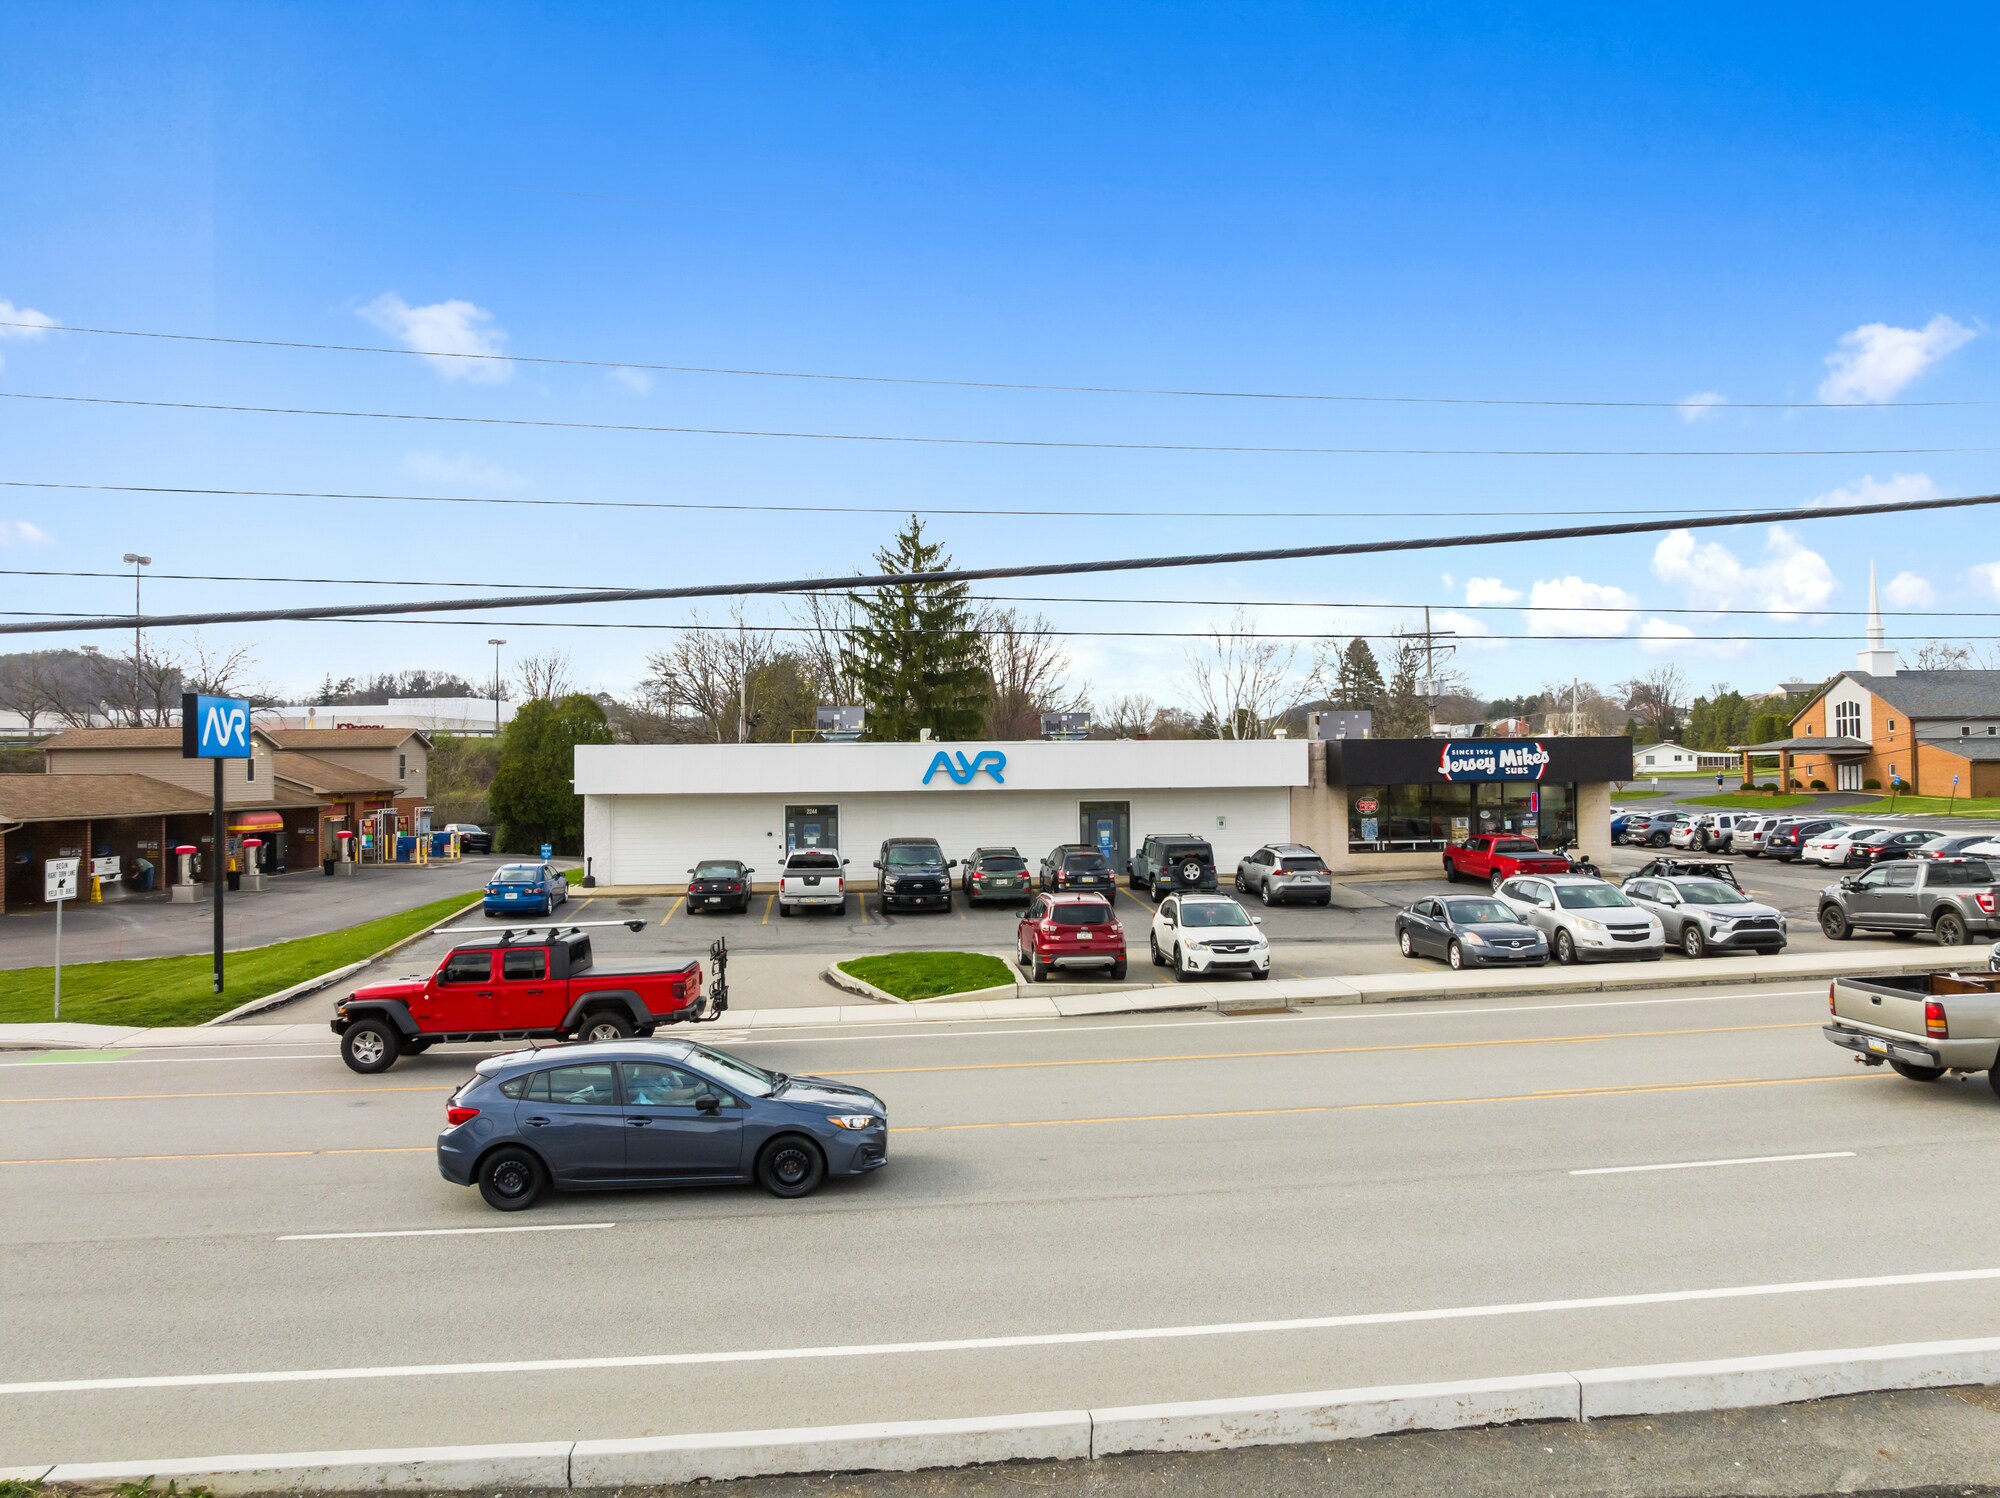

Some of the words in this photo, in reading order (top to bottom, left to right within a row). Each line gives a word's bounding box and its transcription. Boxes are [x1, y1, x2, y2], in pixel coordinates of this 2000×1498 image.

[202, 706, 246, 747] AYR
[922, 751, 1006, 785] AYR
[1437, 755, 1496, 774] Jersey
[1499, 747, 1550, 768] Mike's
[1504, 766, 1529, 775] SUBS
[56, 862, 68, 870] BEGIN
[67, 869, 76, 877] LANE
